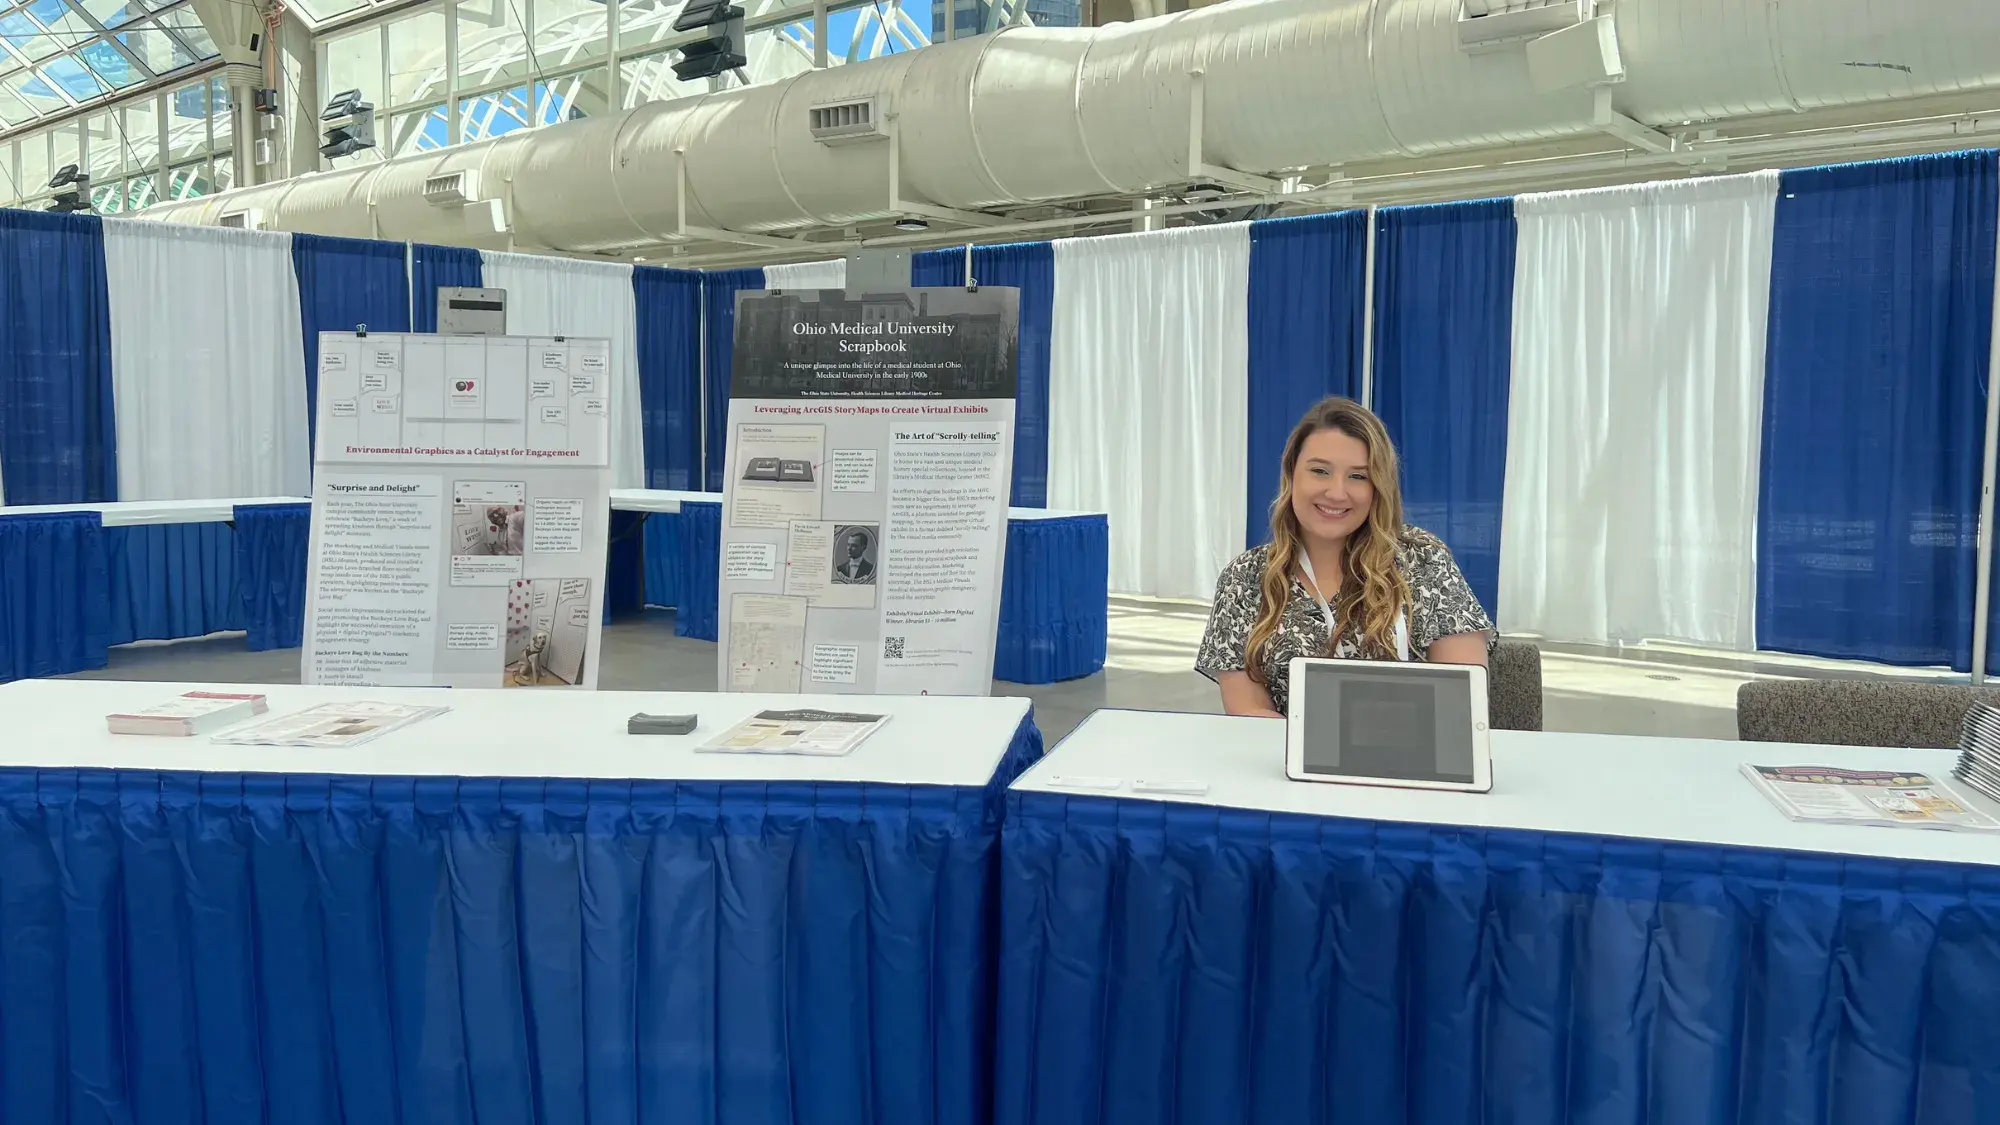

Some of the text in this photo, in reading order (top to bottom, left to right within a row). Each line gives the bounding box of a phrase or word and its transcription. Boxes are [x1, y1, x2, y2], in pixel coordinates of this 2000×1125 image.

[793, 323, 955, 337] Ohio Medical University
[839, 340, 907, 354] Scrapbook
[790, 362, 812, 370] unique
[813, 362, 837, 370] glimpse
[842, 372, 873, 380] University
[894, 372, 909, 380] early
[754, 406, 801, 415] Leveraging
[834, 406, 879, 415] StoryMaps
[346, 446, 413, 454] Environmental
[414, 447, 454, 457] Graphics
[474, 448, 509, 458] Catalyst
[511, 448, 524, 456] for
[525, 448, 579, 458] Engagement
[327, 484, 367, 493] “Surprise
[386, 485, 420, 493] Delight”
